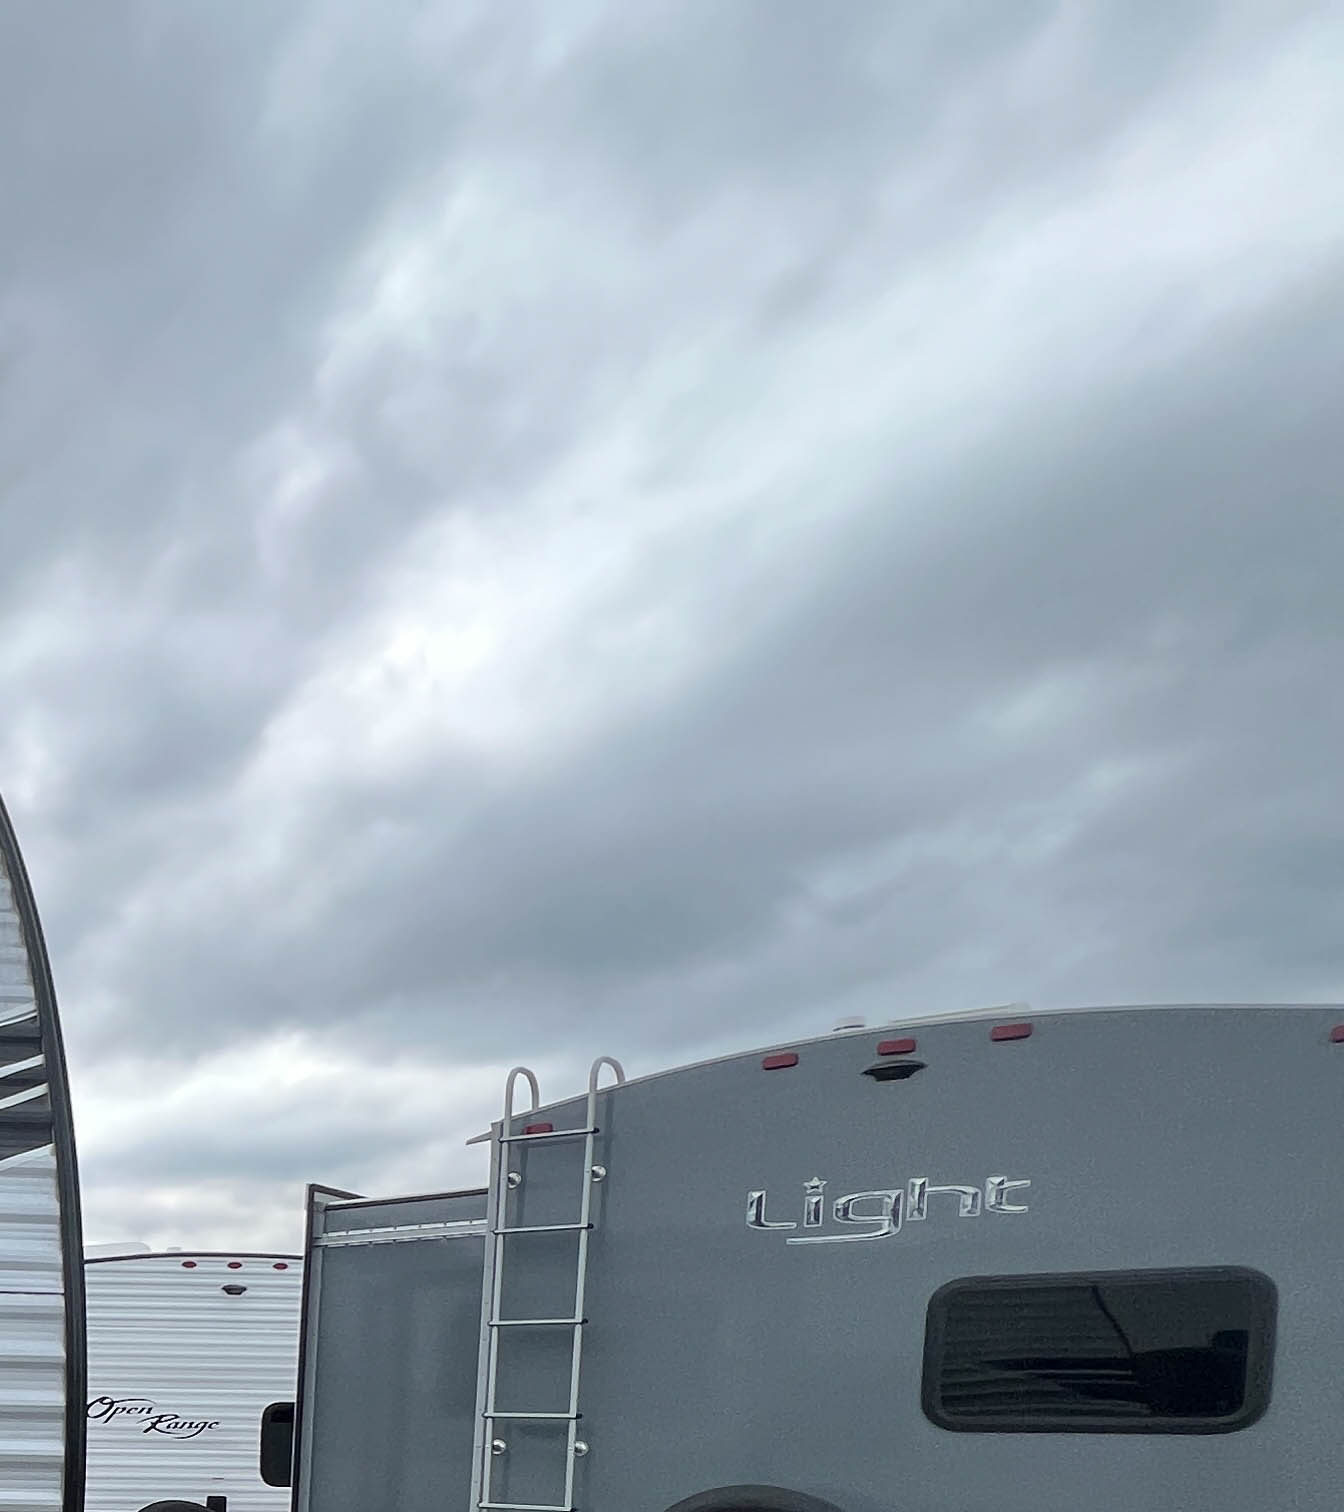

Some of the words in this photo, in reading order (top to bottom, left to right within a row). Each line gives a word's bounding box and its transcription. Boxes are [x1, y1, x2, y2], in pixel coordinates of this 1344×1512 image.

[746, 1176, 1031, 1244] Light
[86, 1396, 157, 1424] Open
[136, 1414, 221, 1439] Range
